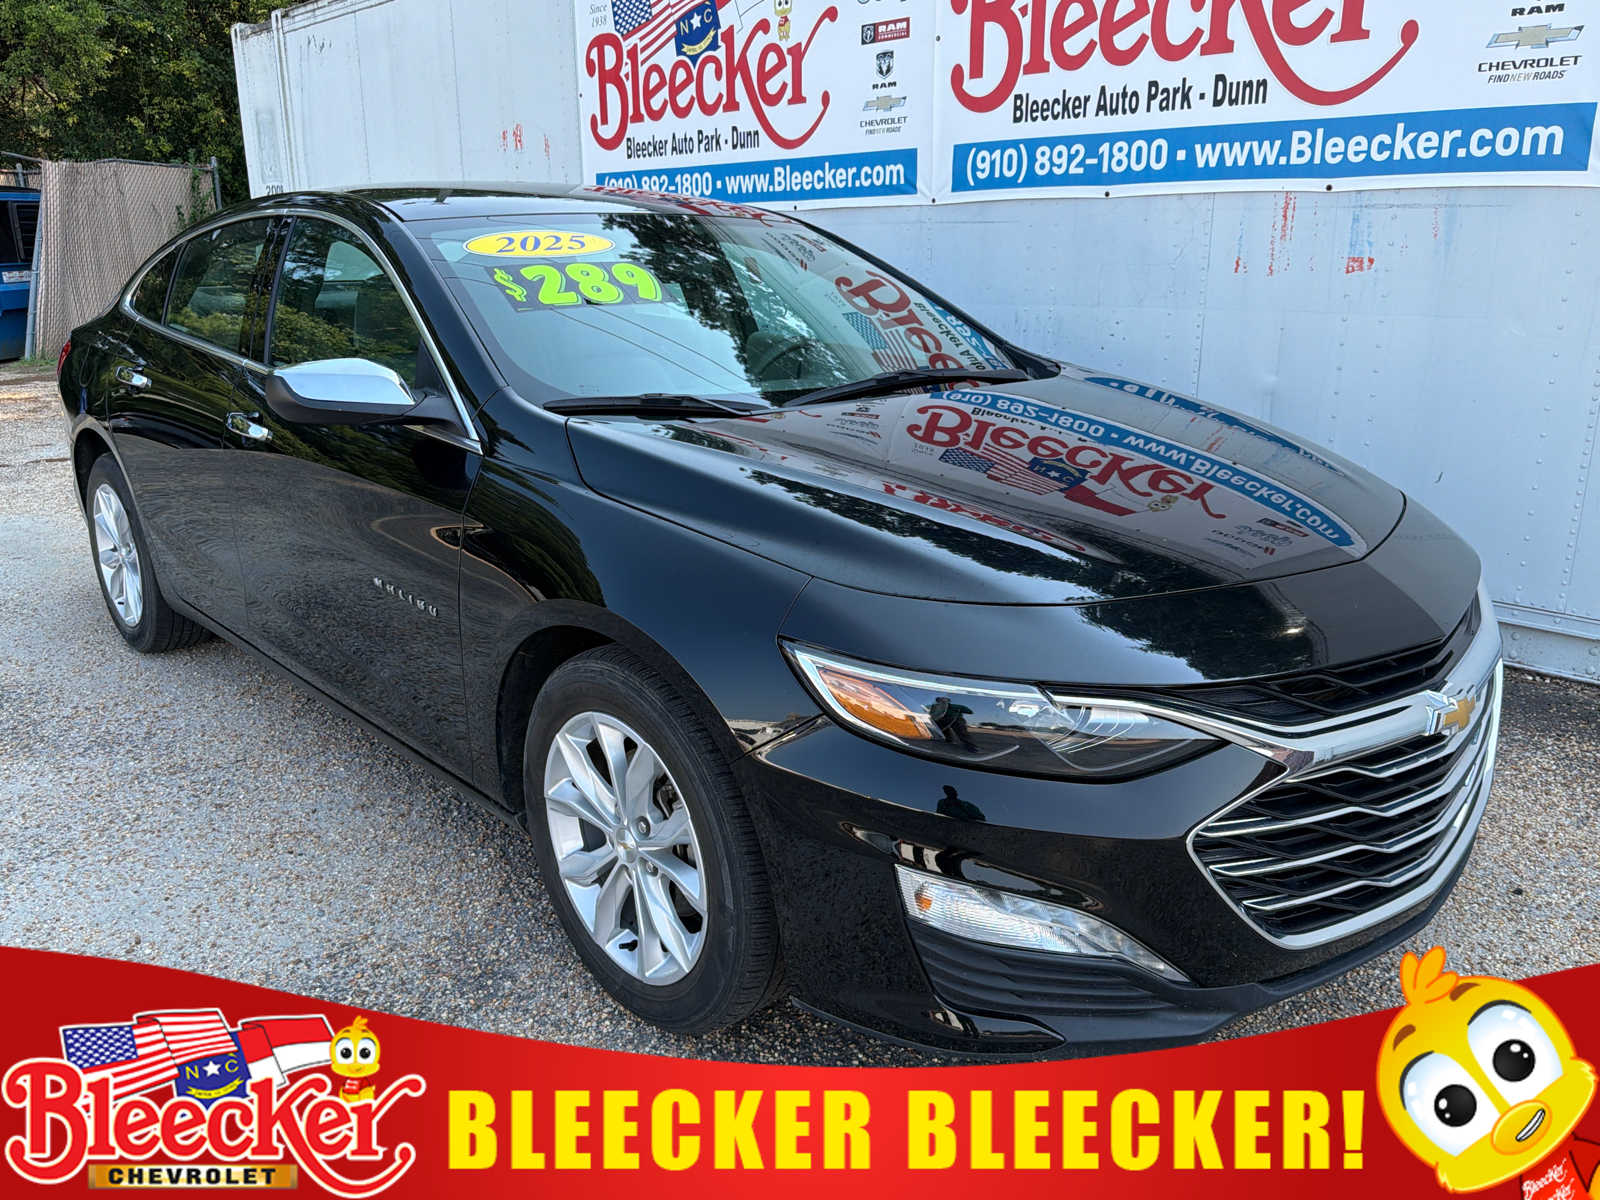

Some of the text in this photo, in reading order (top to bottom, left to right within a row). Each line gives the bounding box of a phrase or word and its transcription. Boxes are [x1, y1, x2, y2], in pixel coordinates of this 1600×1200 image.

[589, 4, 607, 15] Since
[1511, 3, 1565, 16] RAM
[591, 16, 607, 28] 1938
[878, 21, 907, 32] RAM
[1478, 55, 1583, 72] CHEVROLET
[586, 6, 838, 150] Bleecker
[872, 81, 897, 90] RAM
[1012, 73, 1268, 124] Bleecker Auto Park Dunn
[860, 116, 908, 128] CHEVROLET
[626, 125, 760, 159] Bleecker Auto Park Dunn
[966, 123, 1564, 186] (910) 892-1800 www.Bleecker.com
[641, 172, 712, 196] 892-1800
[725, 161, 905, 194] www.Bleecker.com
[496, 235, 586, 254] 2025
[493, 263, 662, 306] $289
[373, 576, 439, 617] MALIBU
